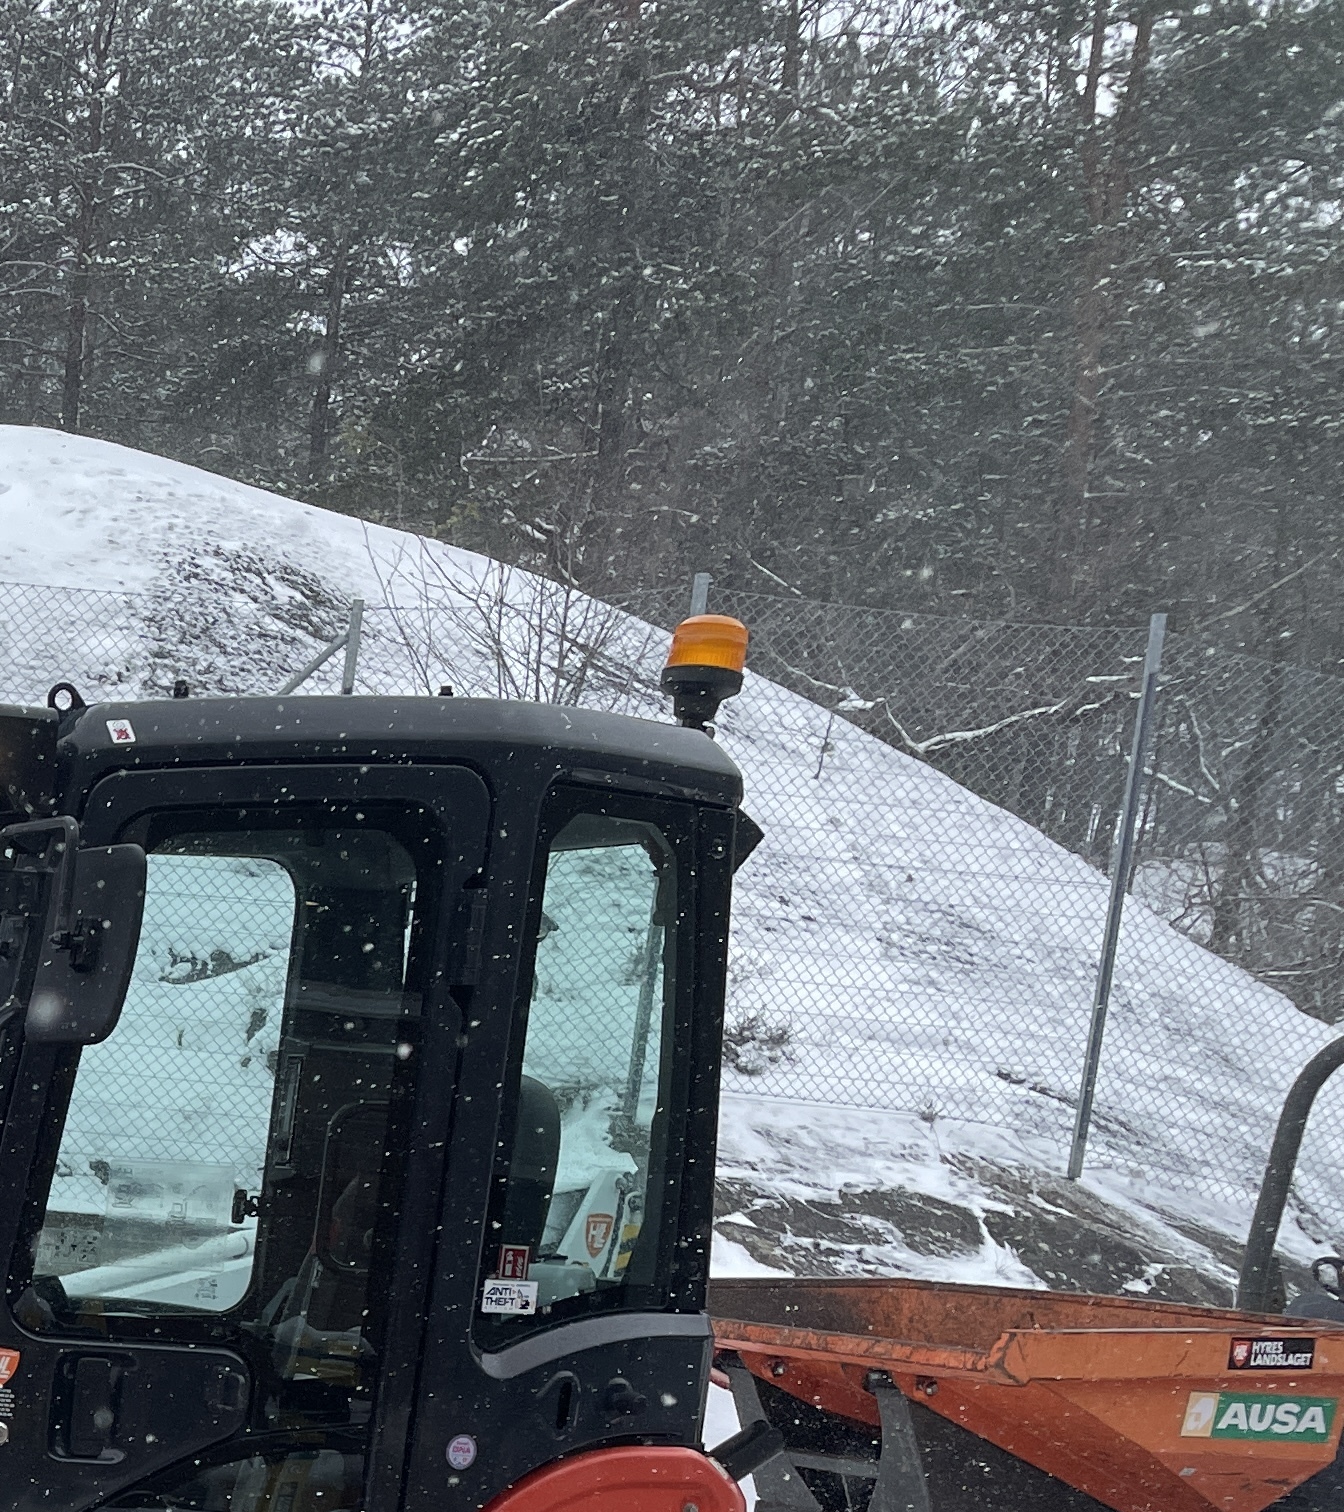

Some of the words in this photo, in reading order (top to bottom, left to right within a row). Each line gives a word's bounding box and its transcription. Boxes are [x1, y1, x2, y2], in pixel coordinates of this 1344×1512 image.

[485, 1286, 512, 1296] ANTI
[484, 1297, 516, 1306] THEFT
[1252, 1341, 1284, 1354] HYRES
[1250, 1353, 1312, 1366] LANDSLAGET
[1215, 1402, 1327, 1435] AUSA
